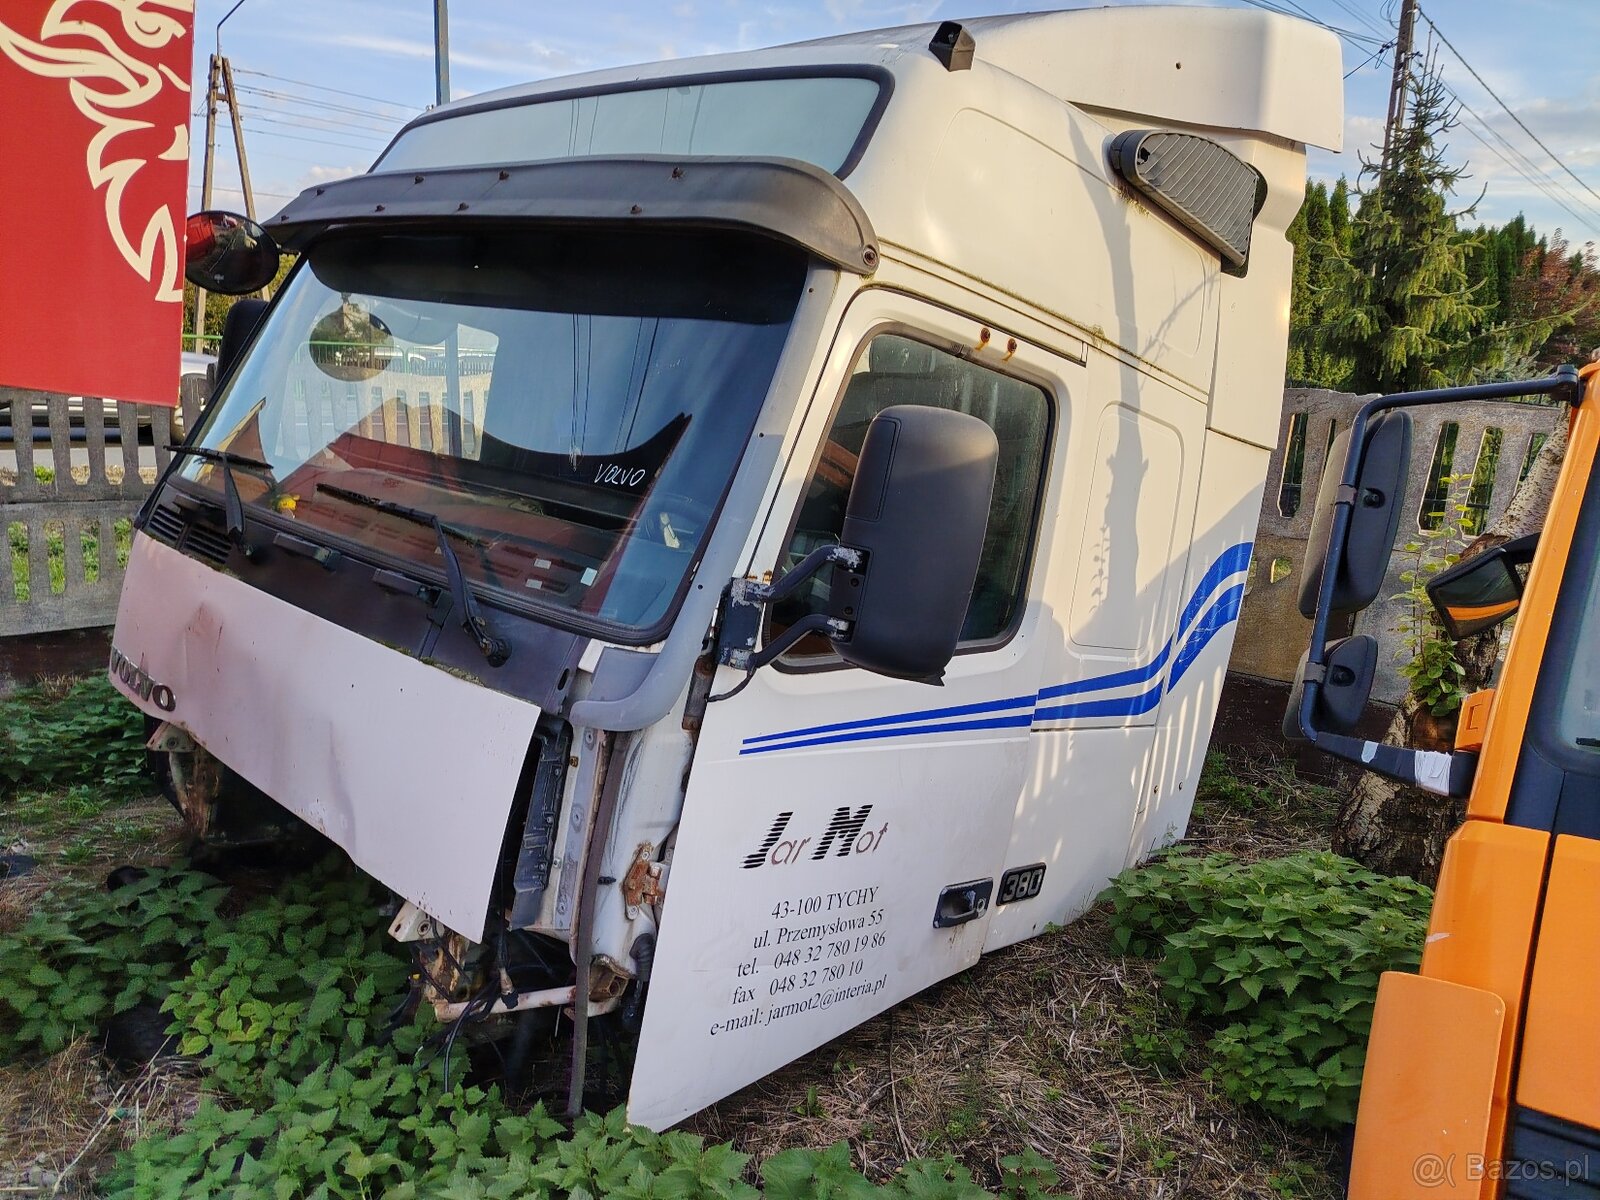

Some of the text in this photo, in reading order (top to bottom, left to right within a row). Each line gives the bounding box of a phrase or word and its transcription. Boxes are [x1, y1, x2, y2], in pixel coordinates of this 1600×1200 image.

[594, 463, 645, 487] VOLVO
[110, 647, 176, 712] VOLVO
[739, 804, 888, 869] Jar Mot
[771, 886, 879, 919] 43-100 TYCHY
[1002, 868, 1043, 901] 380
[753, 929, 771, 949] ul.
[867, 908, 884, 927] 55
[737, 957, 759, 978] tel.
[774, 948, 801, 970] 048
[804, 945, 822, 963] 32
[827, 939, 850, 958] 780
[732, 958, 864, 1005] fax 048 32 780 10
[710, 974, 888, 1036] e-mail: jarmot2@interia.pl
